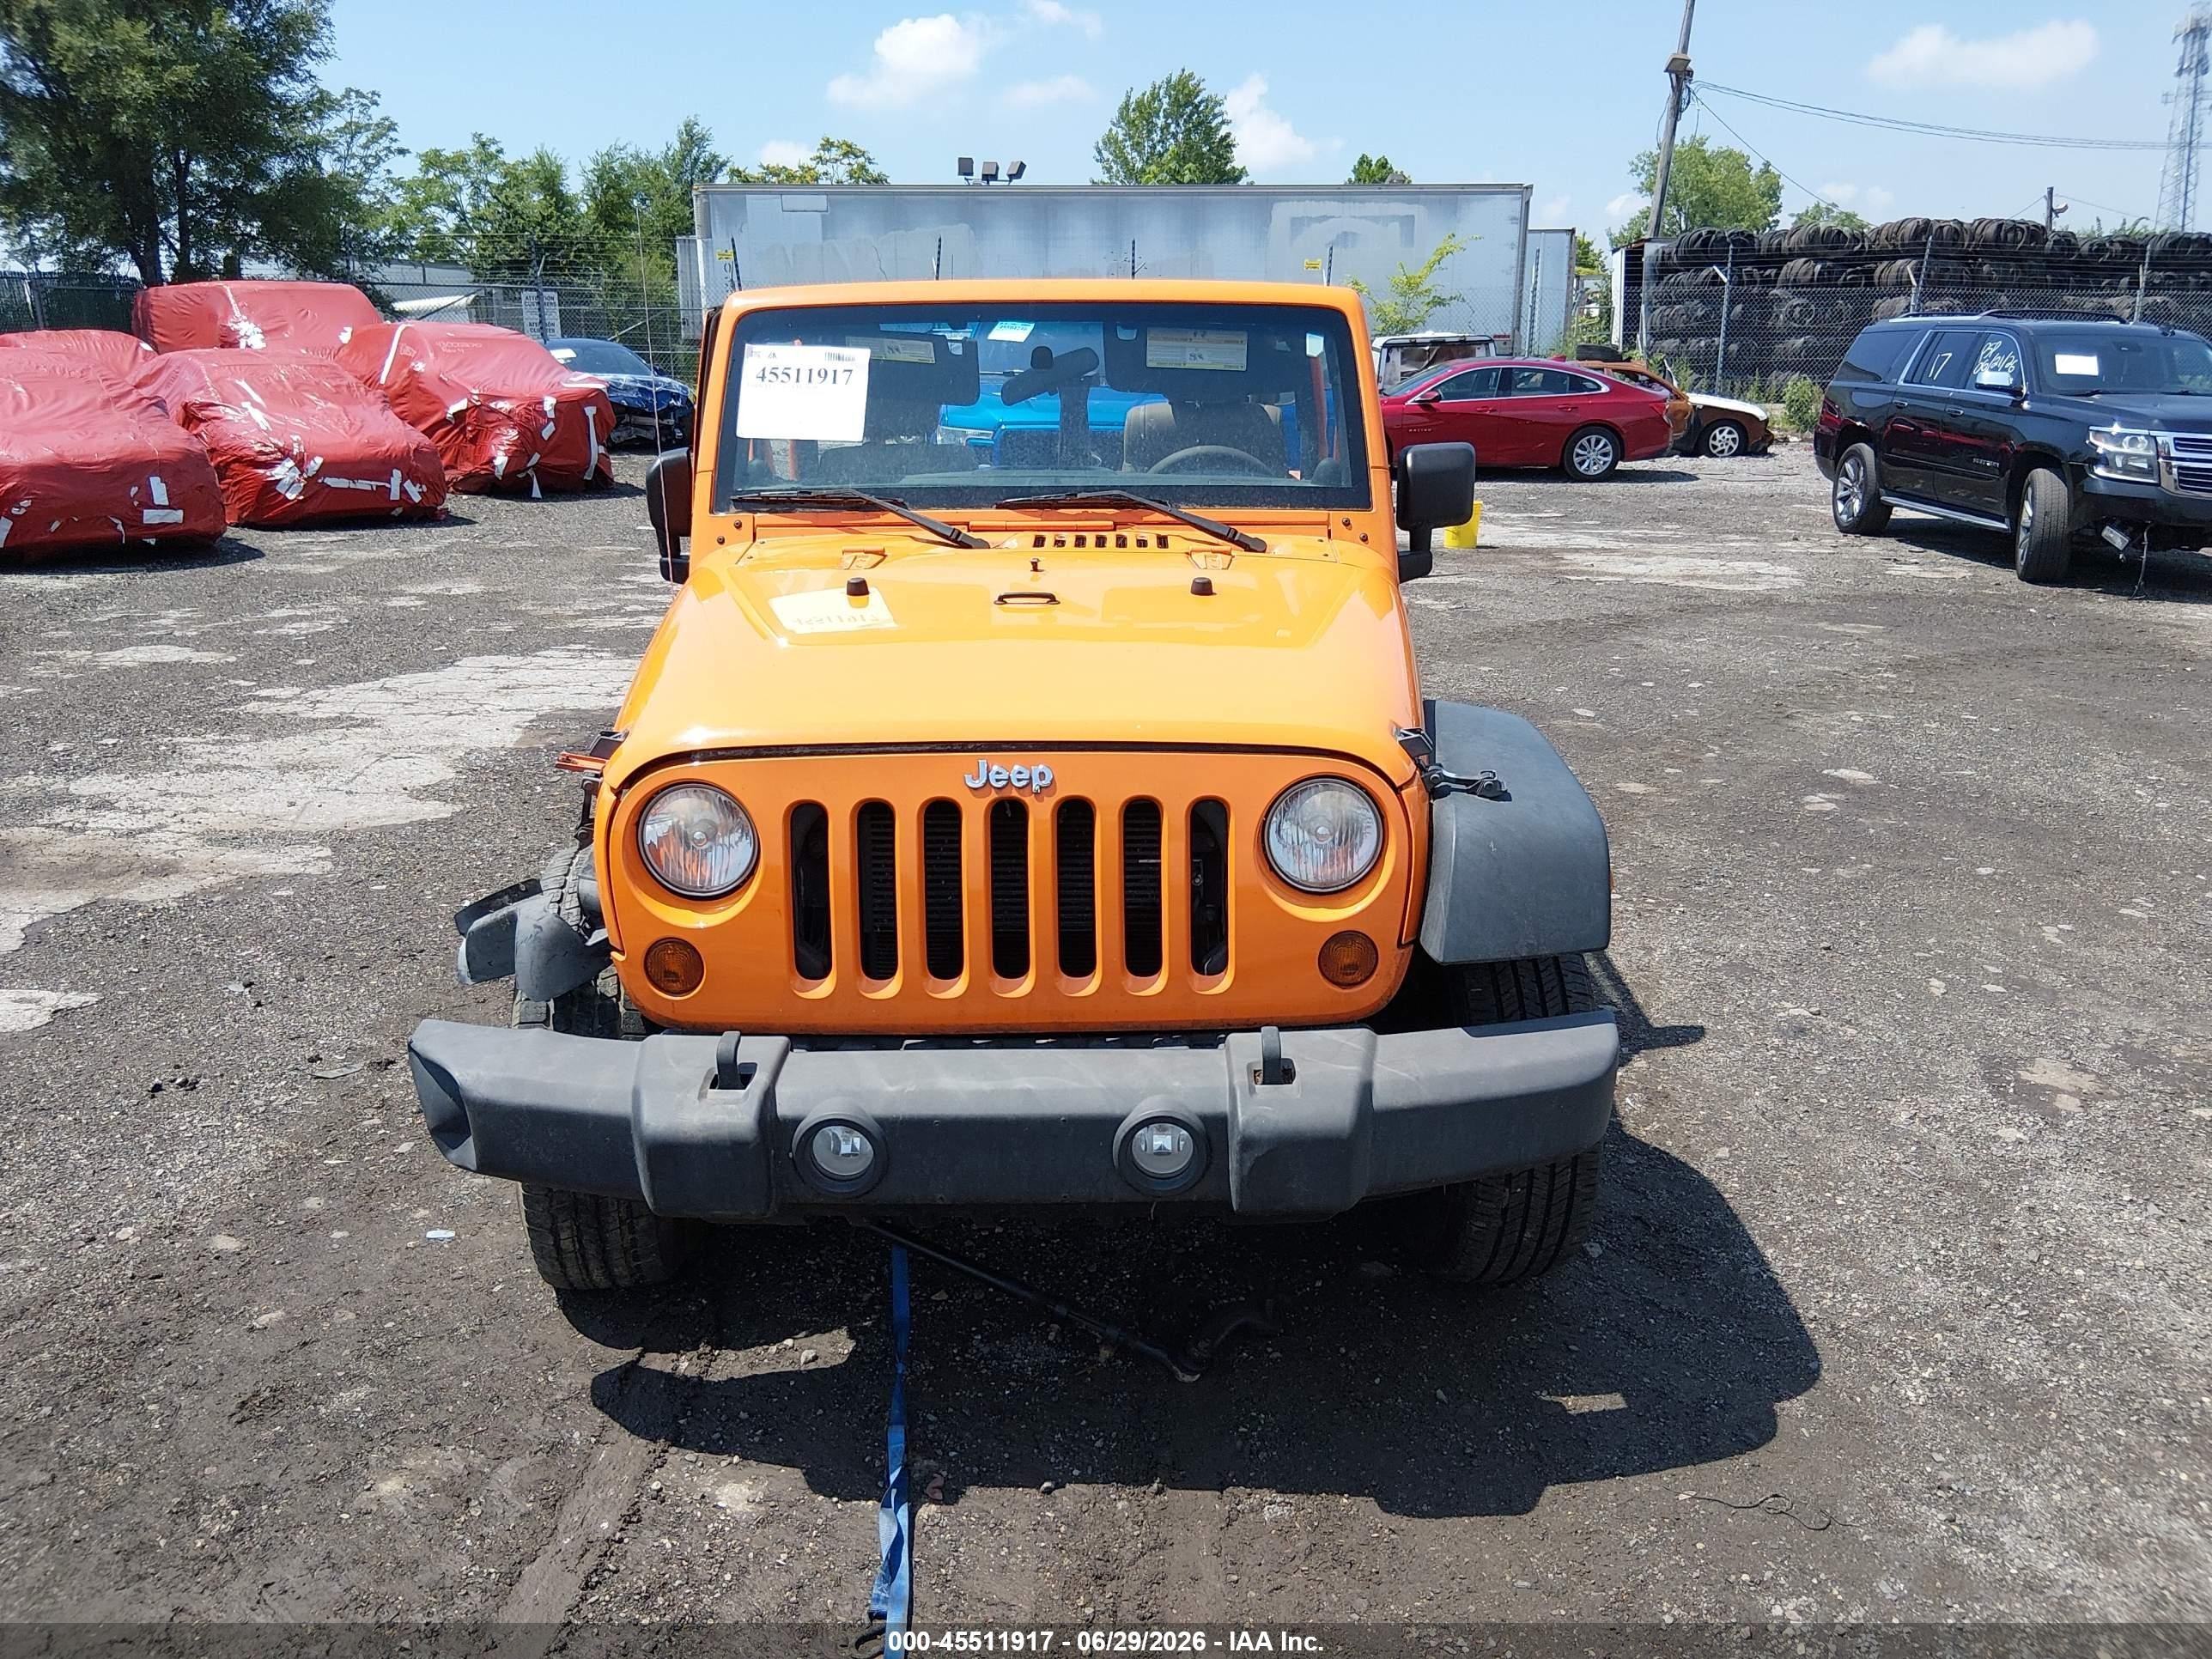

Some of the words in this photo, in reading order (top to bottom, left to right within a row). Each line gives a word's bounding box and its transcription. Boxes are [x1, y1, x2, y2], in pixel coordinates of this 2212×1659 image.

[756, 367, 854, 385] 45511917
[1929, 352, 1953, 380] 17
[963, 759, 1054, 793] Jeep
